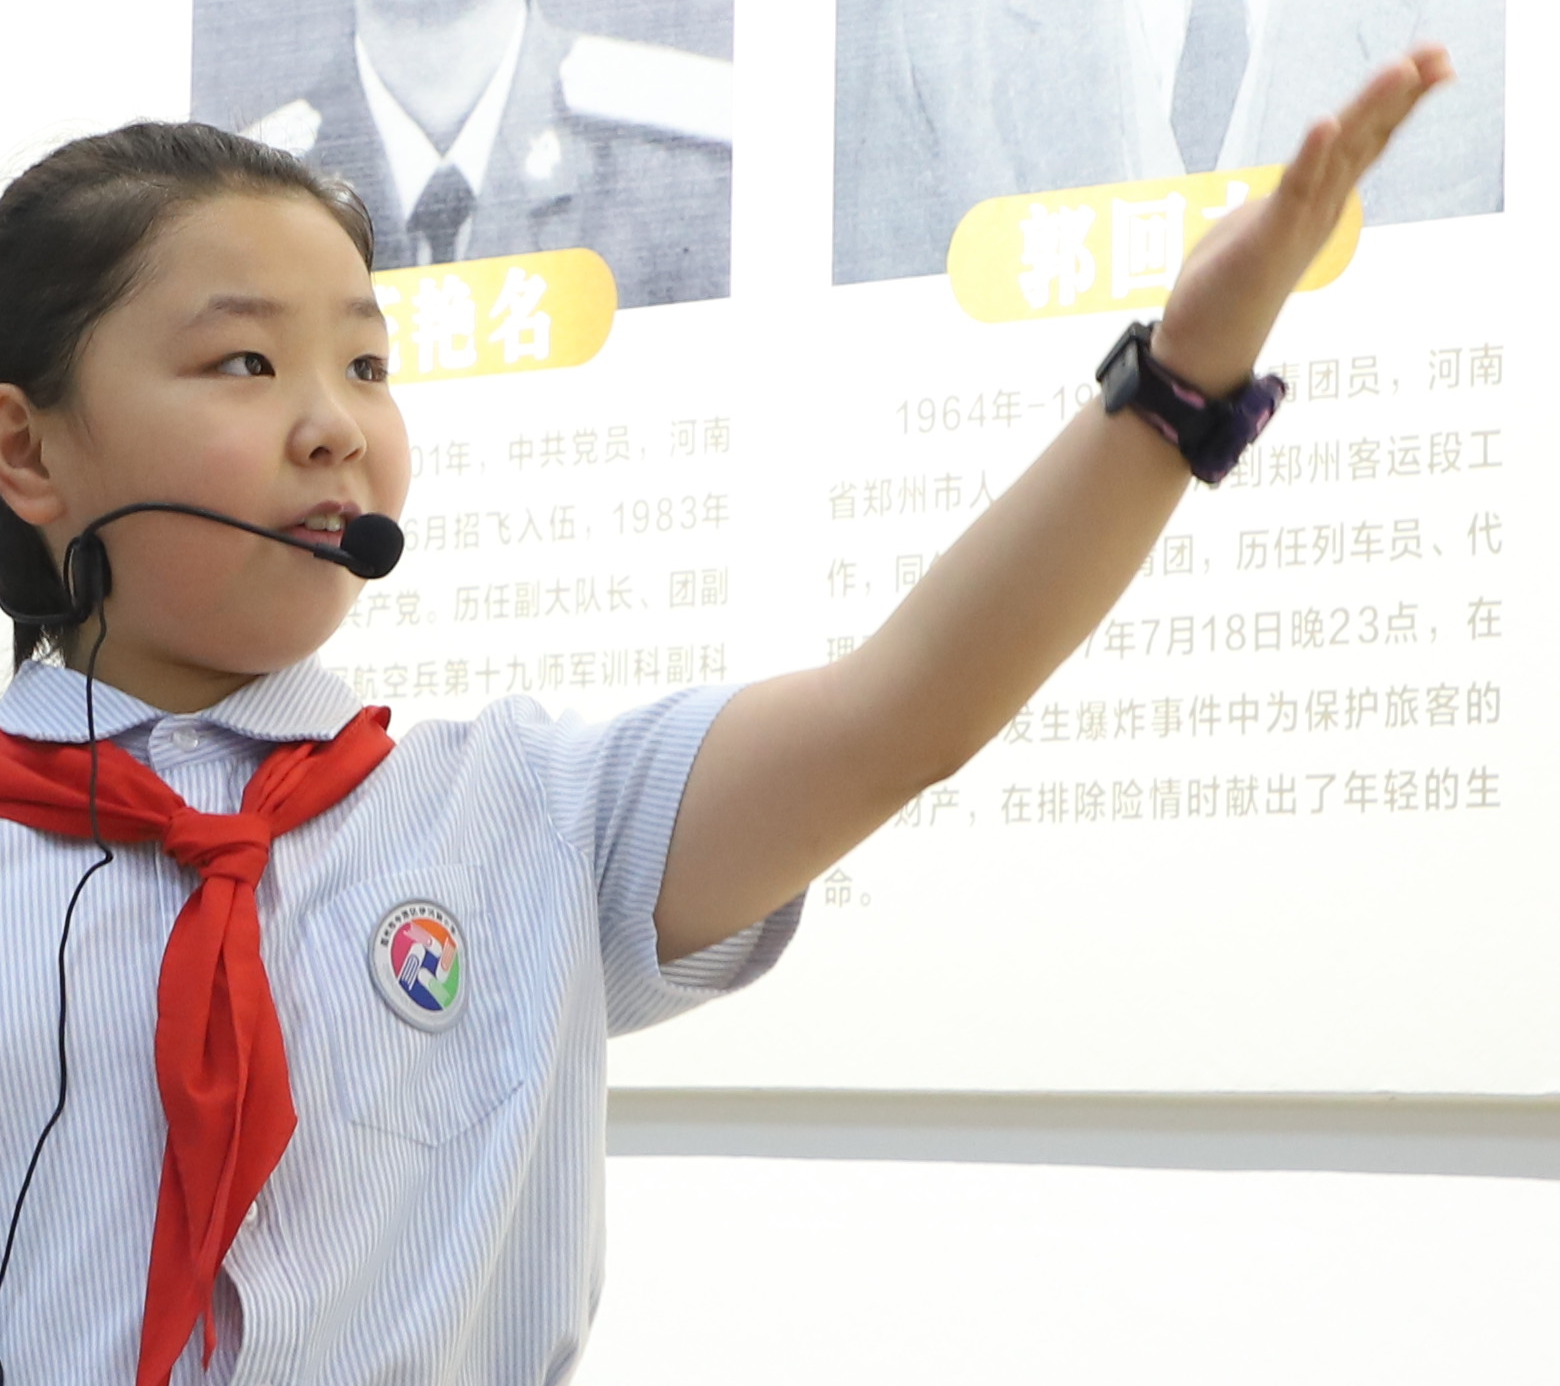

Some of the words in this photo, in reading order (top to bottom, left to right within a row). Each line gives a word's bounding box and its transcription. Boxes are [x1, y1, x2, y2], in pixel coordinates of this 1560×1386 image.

[1017, 181, 1250, 310] 郭回
[1194, 428, 1504, 493] 到郑州客运段工
